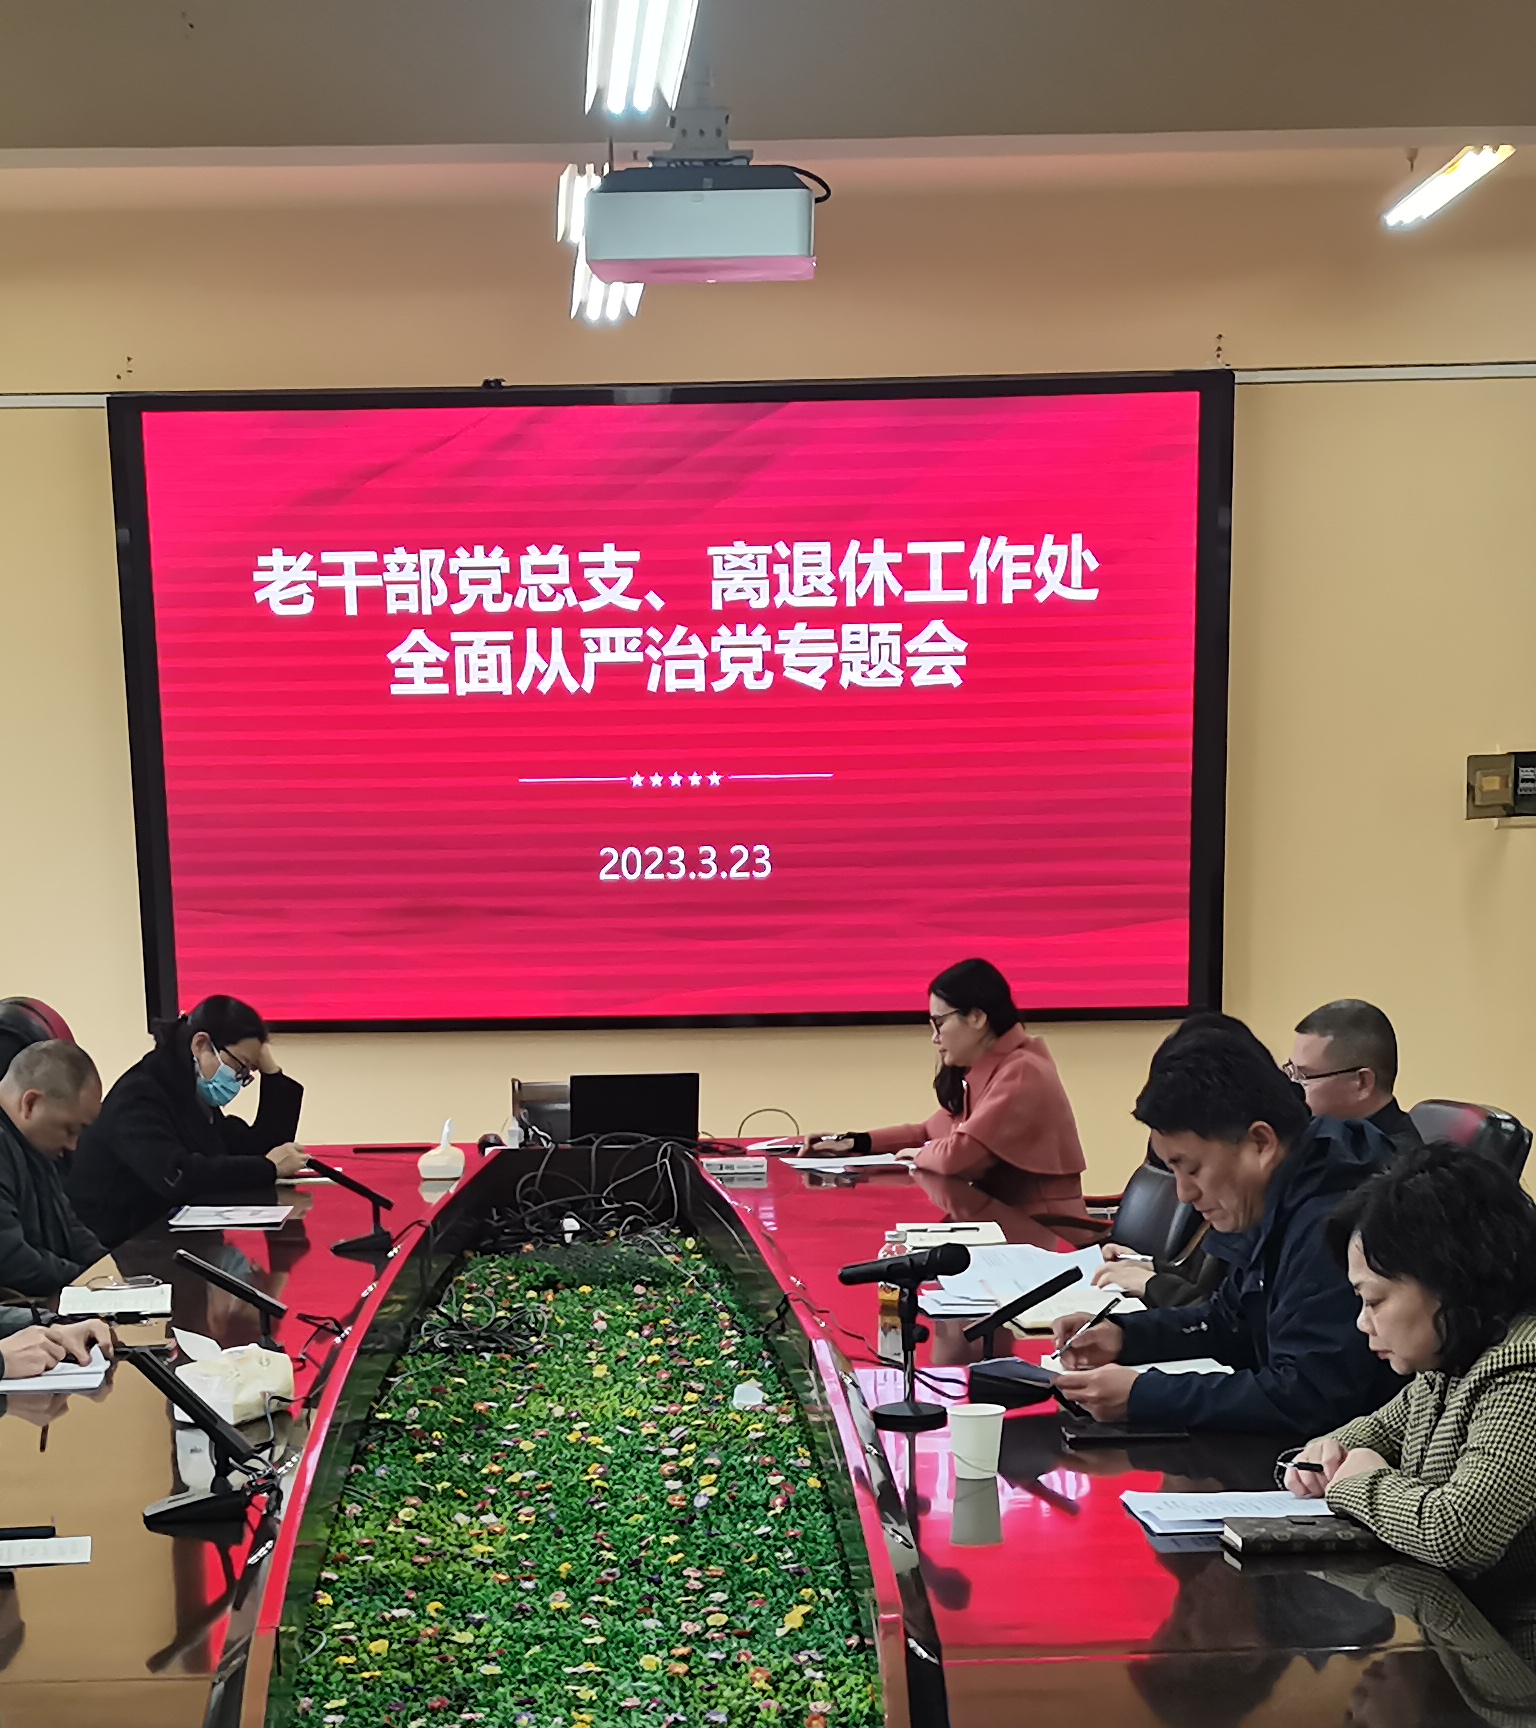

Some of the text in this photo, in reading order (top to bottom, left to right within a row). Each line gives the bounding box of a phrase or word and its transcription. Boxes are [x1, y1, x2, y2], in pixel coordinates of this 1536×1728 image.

[253, 533, 1101, 618] 老干部党总支、离退休工作处
[386, 620, 969, 698] 全面从严治党专题会
[597, 843, 774, 882] 2023.3.23
